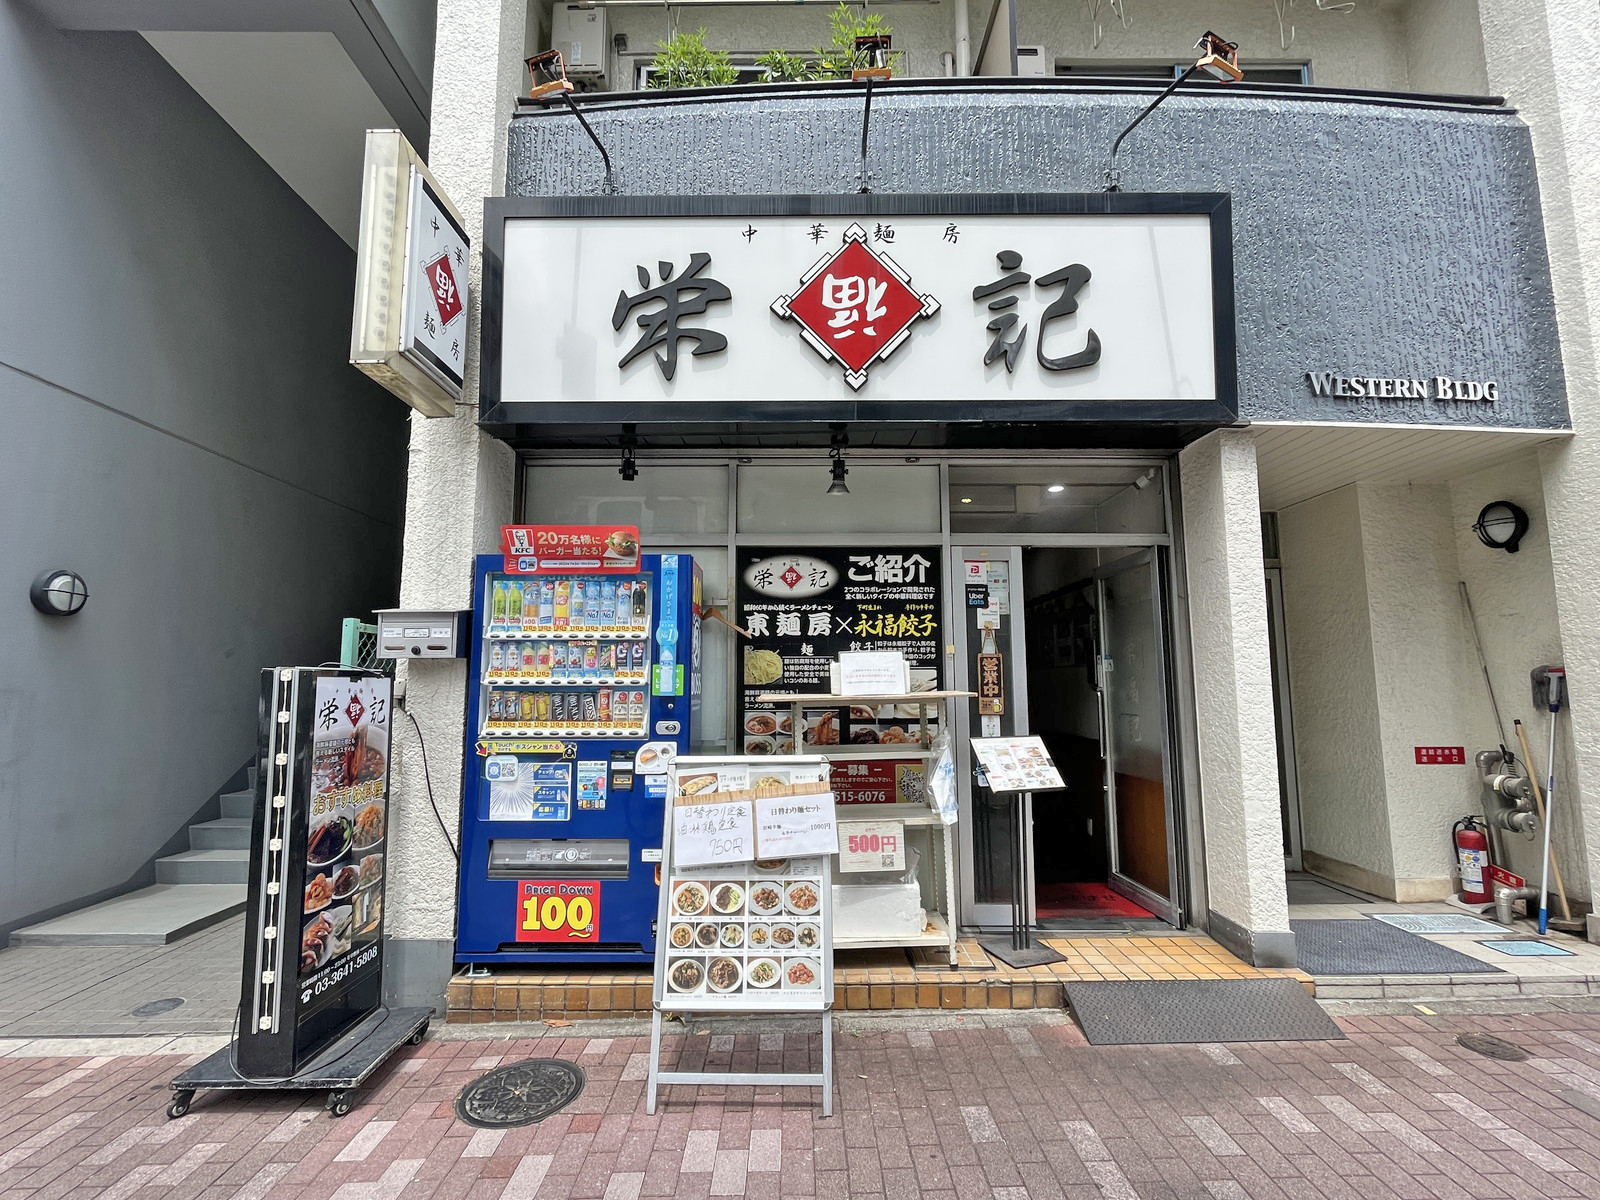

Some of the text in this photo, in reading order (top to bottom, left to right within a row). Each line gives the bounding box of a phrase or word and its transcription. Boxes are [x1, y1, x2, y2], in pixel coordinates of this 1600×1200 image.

[740, 222, 962, 245] 中華麺房
[1309, 371, 1499, 401] WESTERN BLDG
[537, 531, 602, 545] 20万名様に
[847, 553, 931, 584] ご紹介
[968, 592, 985, 600] Uber
[800, 642, 815, 656] 麺
[982, 657, 999, 698] 営業中
[312, 780, 384, 817] おすすめ料理
[770, 804, 821, 816] 日替わり麺セット
[848, 834, 897, 854] 500円
[524, 884, 594, 896] PRICE DOWN
[314, 945, 378, 996] 03-3641-5808
